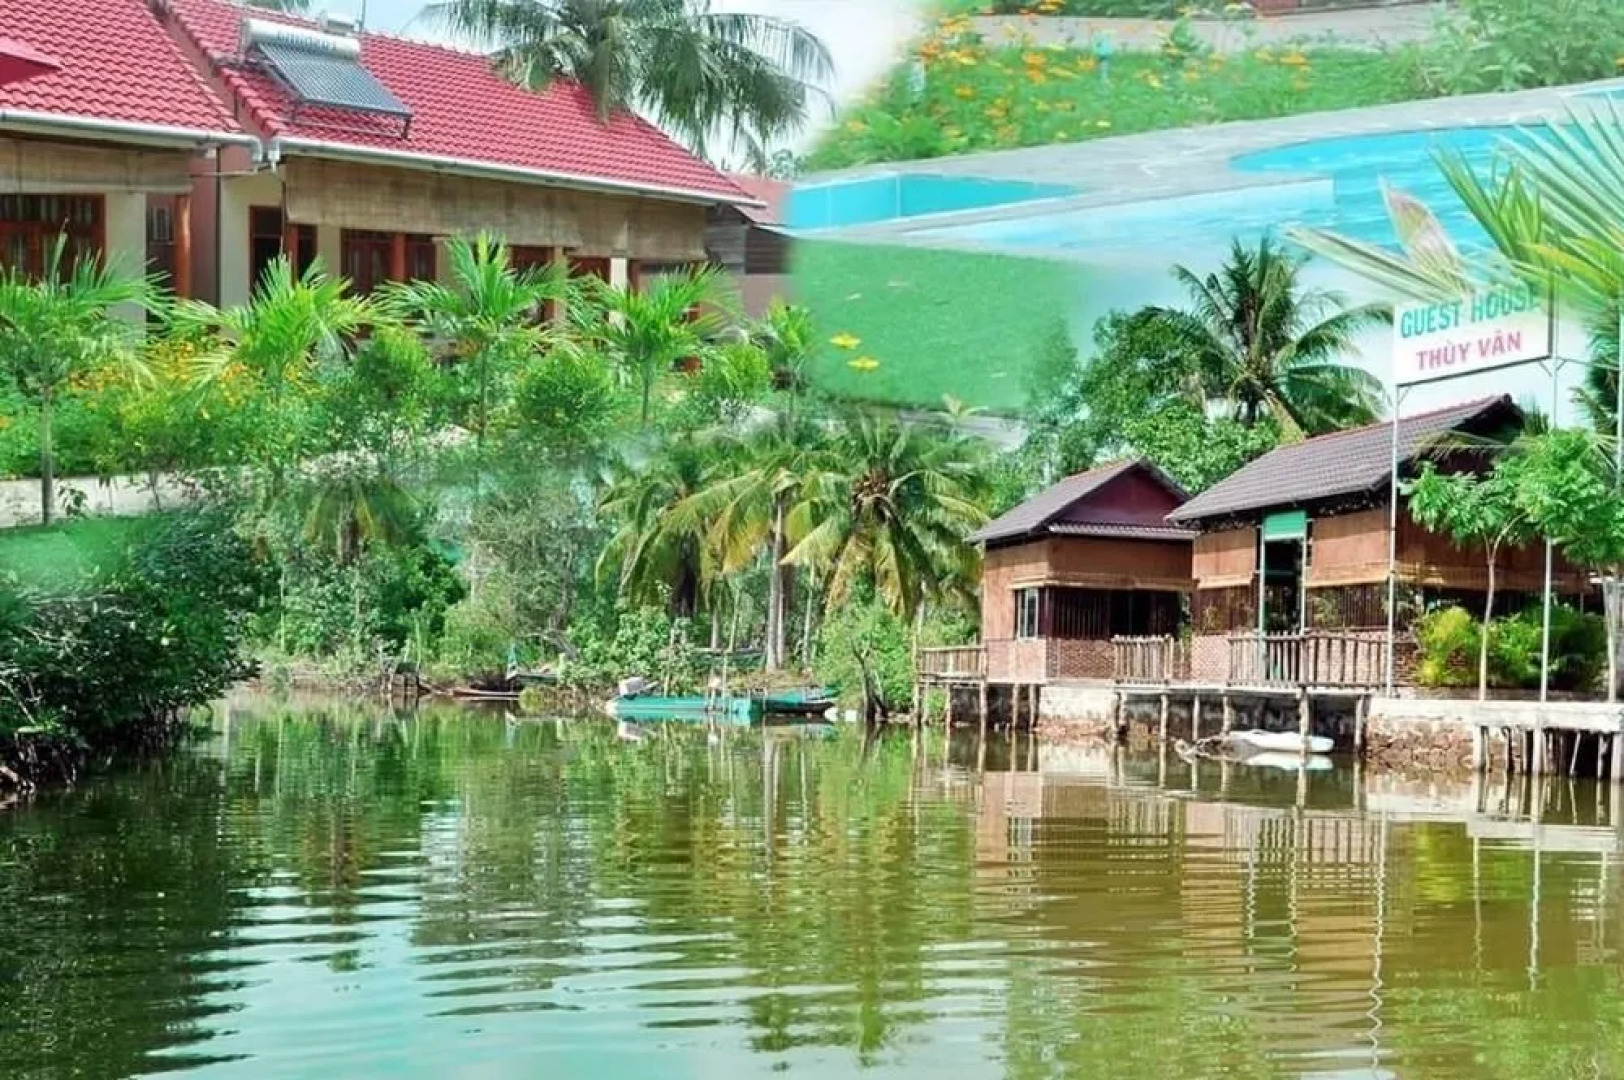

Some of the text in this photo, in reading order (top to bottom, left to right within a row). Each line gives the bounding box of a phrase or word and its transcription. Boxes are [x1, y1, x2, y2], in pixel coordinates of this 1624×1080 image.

[1401, 283, 1542, 338] GUEST HOUSE
[1416, 329, 1521, 371] THÙY VÂN
